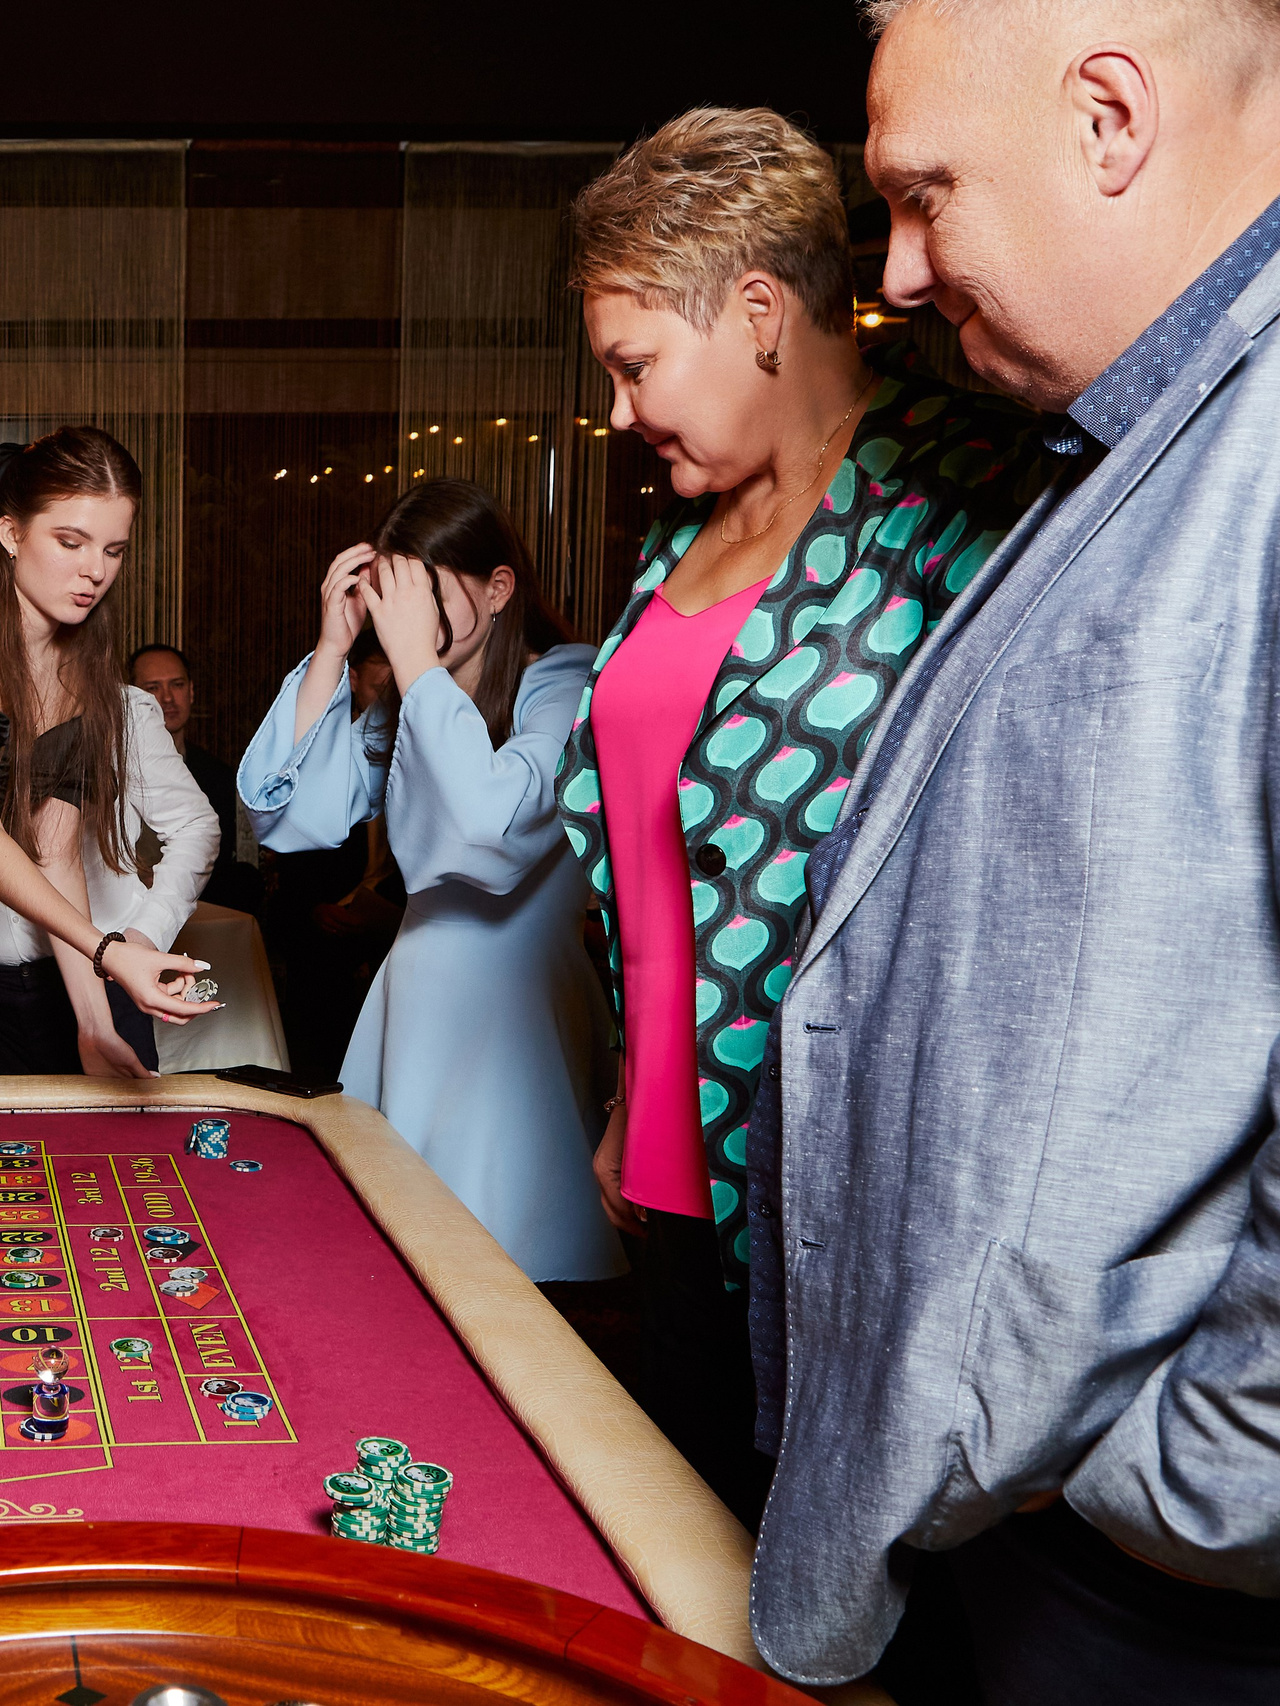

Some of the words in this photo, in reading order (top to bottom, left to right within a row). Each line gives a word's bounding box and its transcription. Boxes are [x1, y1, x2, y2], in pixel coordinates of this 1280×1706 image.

[0, 1175, 33, 1185] 31
[71, 1172, 98, 1184] 12
[77, 1187, 104, 1205] 3rd
[142, 1192, 175, 1219] ODD
[1, 1231, 44, 1243] 22
[89, 1247, 121, 1263] 12
[95, 1267, 130, 1292] 2nd
[9, 1299, 54, 1313] 13
[11, 1327, 57, 1342] 10
[189, 1322, 237, 1369] EVEN
[127, 1379, 163, 1403] 1st
